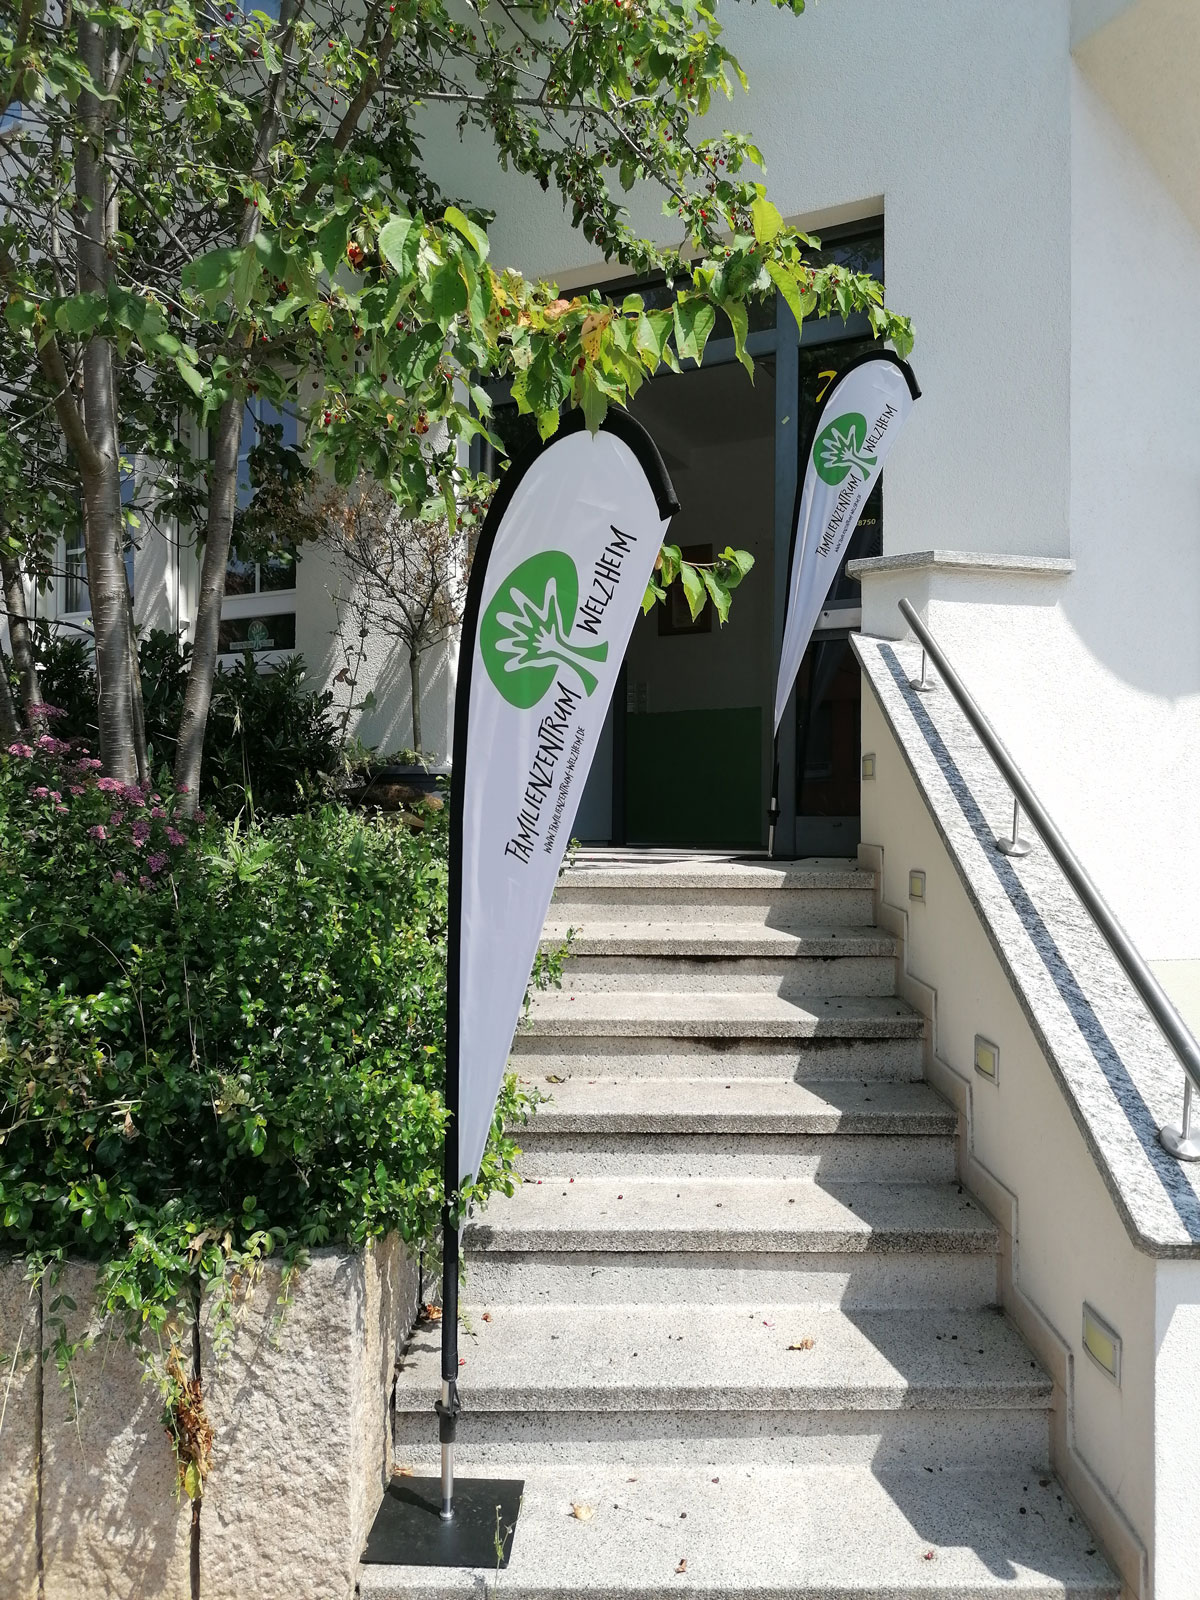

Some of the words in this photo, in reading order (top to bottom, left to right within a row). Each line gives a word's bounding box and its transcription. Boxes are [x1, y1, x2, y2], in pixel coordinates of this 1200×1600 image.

[815, 370, 838, 403] 7
[815, 473, 862, 558] FAMILIENZENTRUM
[862, 403, 898, 453] WELZHEIM
[504, 681, 582, 864] FAMILIENZENTRUM
[576, 525, 637, 635] WELZHEIM
